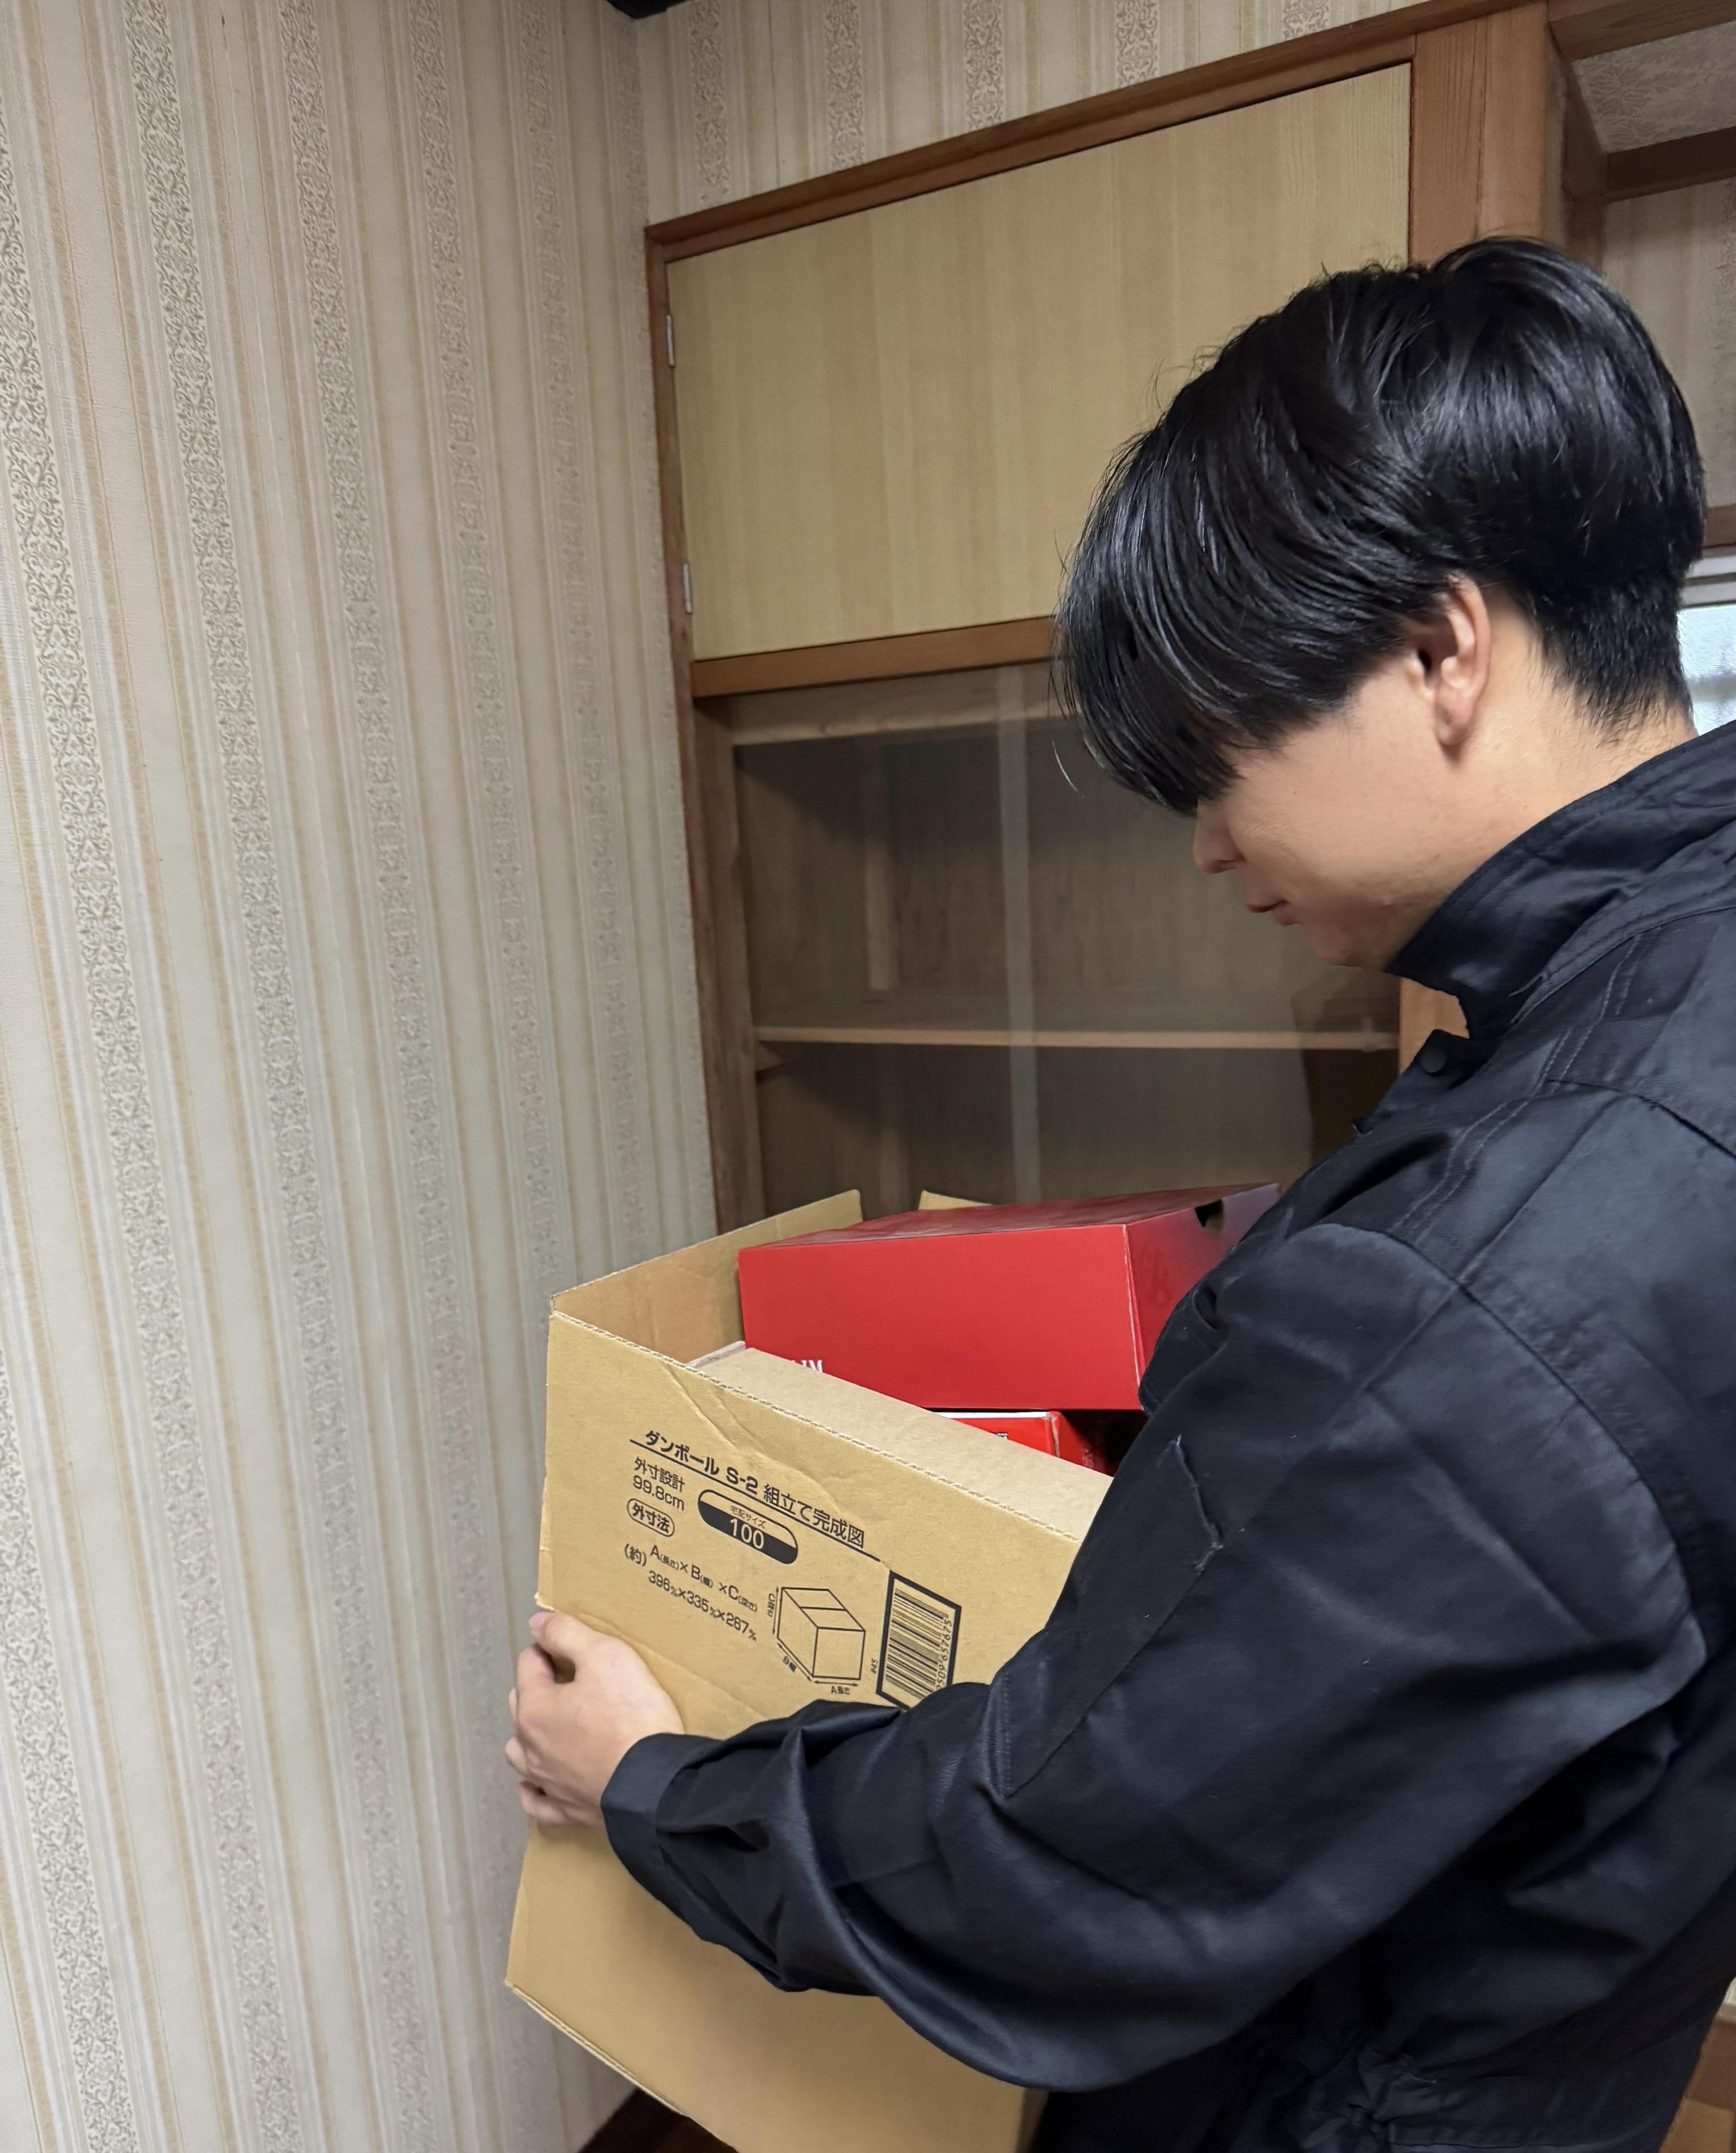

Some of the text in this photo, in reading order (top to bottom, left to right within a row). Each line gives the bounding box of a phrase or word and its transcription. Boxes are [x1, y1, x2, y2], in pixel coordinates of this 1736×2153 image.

[634, 1456, 685, 1492] 外寸設計
[645, 1430, 865, 1549] ダンボール S-2 組立て完成図
[633, 1475, 685, 1511] 99.8cm
[632, 1502, 670, 1533] 外寸法
[730, 1505, 766, 1529] 宅配サイズ
[730, 1518, 764, 1549] 100
